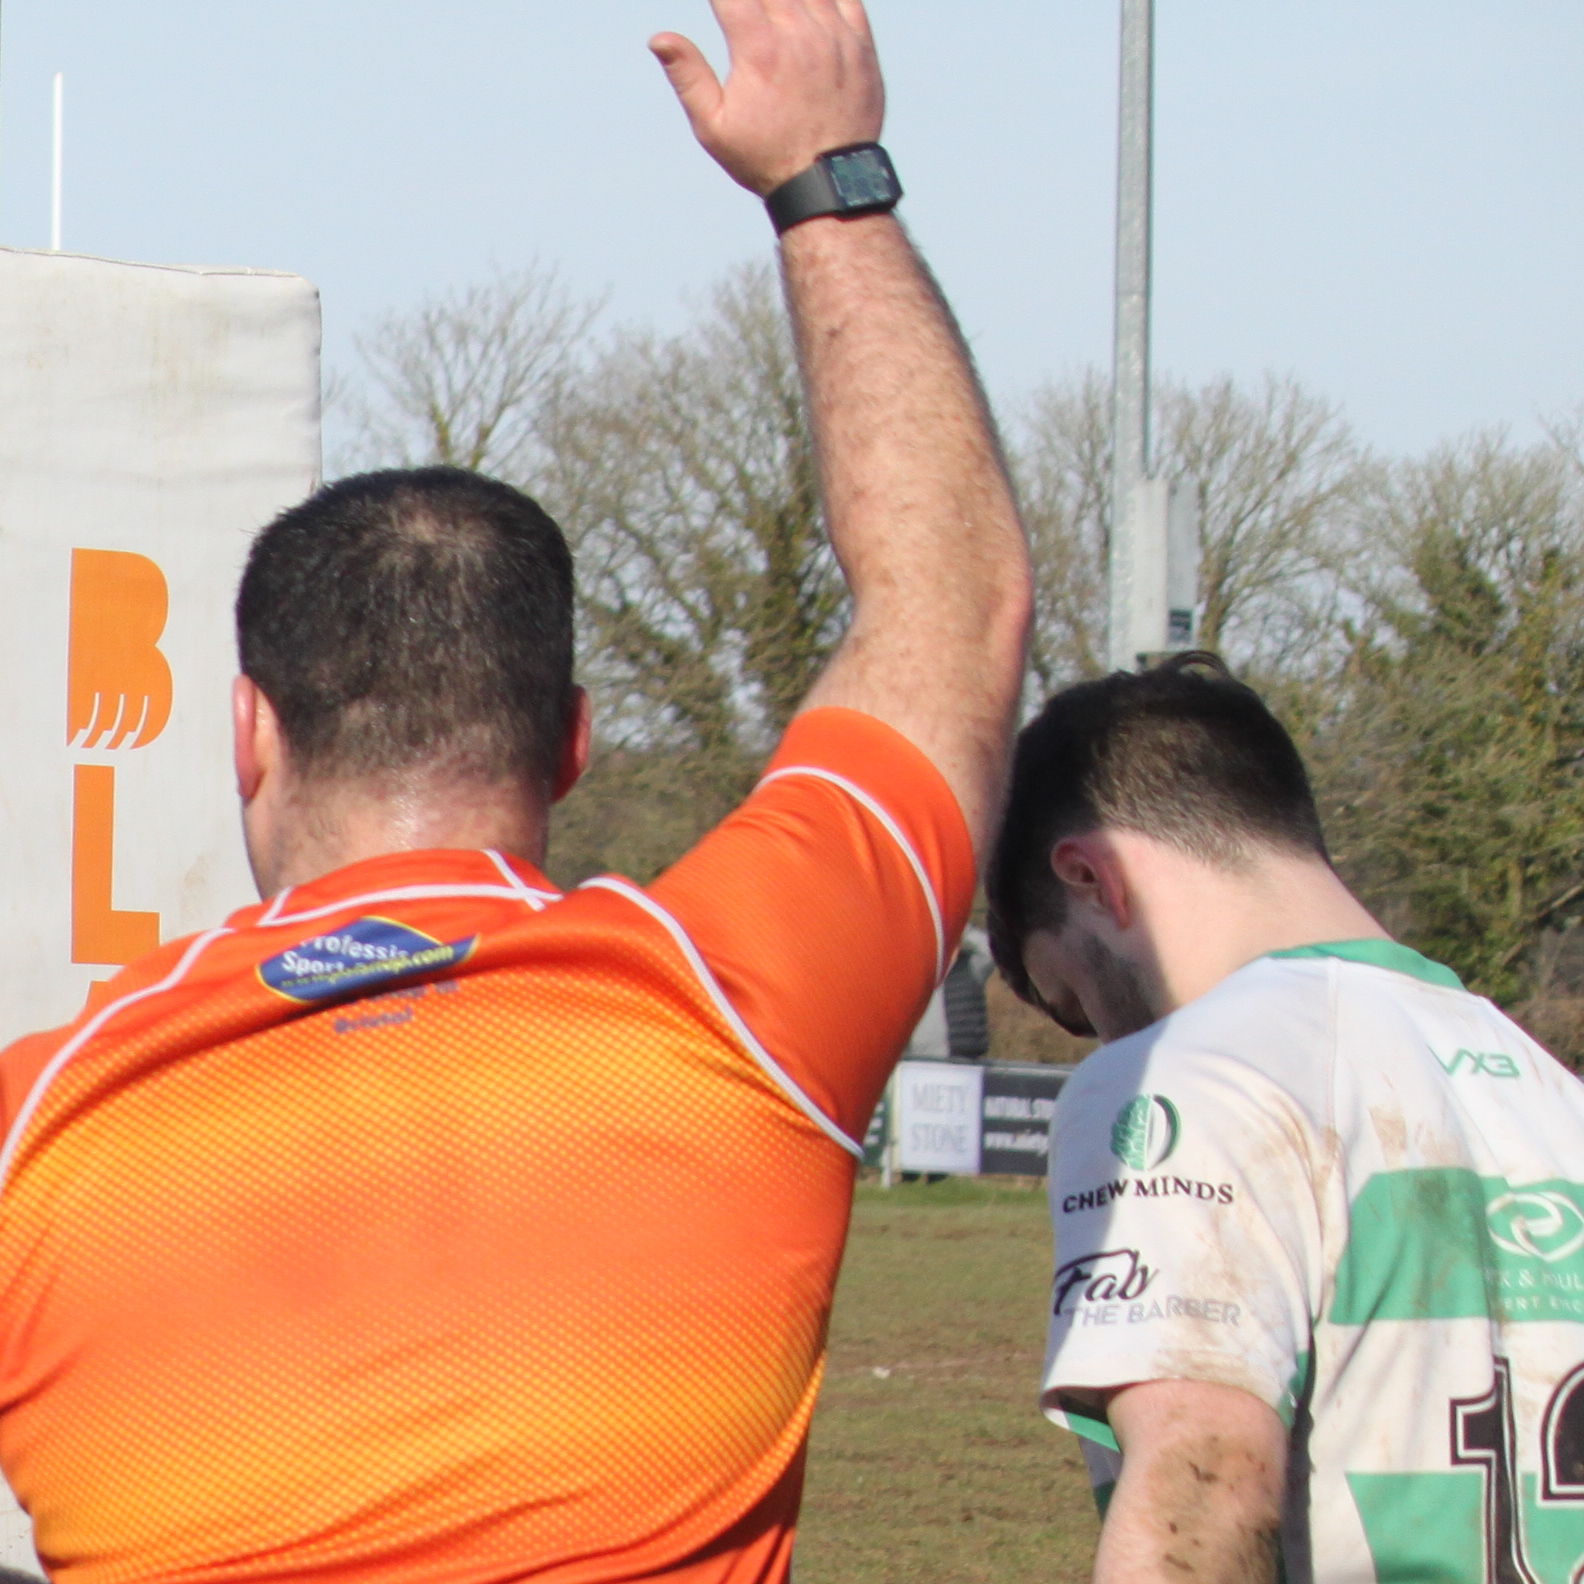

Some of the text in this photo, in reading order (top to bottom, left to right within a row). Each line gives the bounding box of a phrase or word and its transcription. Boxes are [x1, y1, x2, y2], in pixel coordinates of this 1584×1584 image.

[66, 548, 173, 1019] BL
[1061, 1175, 1235, 1214] CHEW MINDS
[1053, 1248, 1160, 1316] Fab
[1065, 1294, 1242, 1327] THE BARBER
